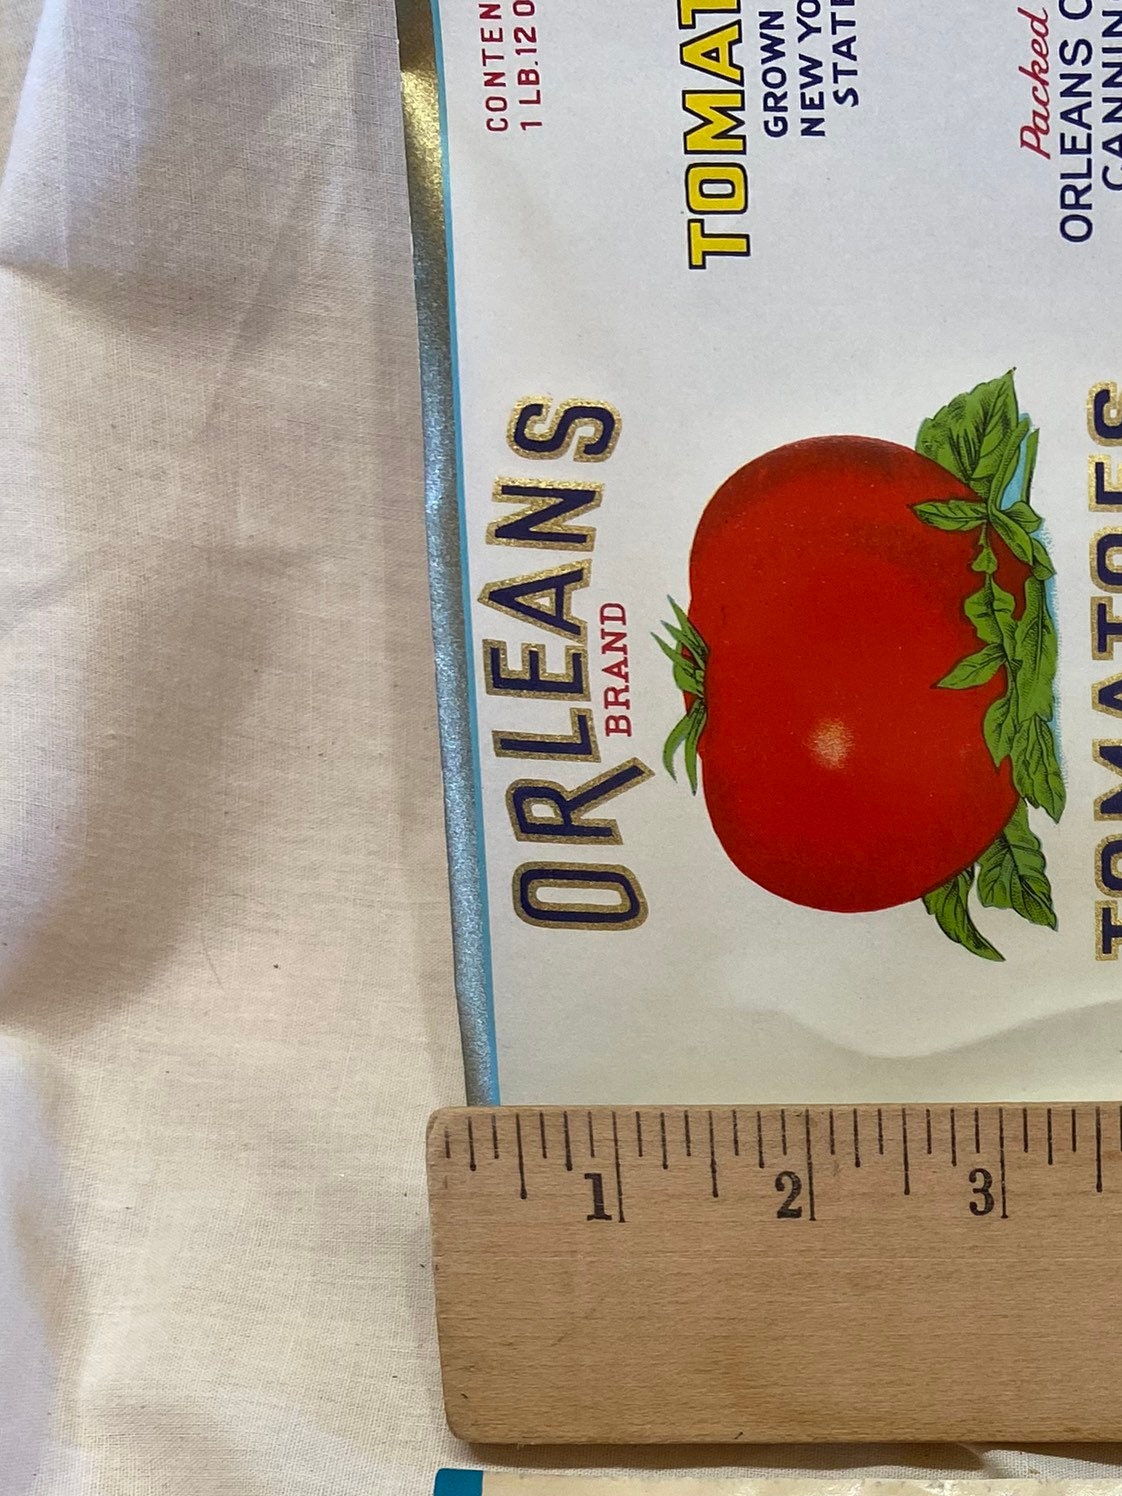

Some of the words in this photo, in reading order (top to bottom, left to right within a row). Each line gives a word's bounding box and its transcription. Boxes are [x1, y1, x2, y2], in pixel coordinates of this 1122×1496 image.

[478, 3, 508, 132] CONTEN
[758, 11, 789, 138] GROWN
[796, 0, 822, 43] YO
[1017, 6, 1052, 161] Packed
[520, 121, 543, 132] 1
[677, 0, 750, 270] TOMAT
[798, 53, 826, 137] NEW
[1058, 38, 1094, 243] ORLEANS
[477, 395, 655, 932] ORLEANS
[599, 601, 633, 738] BRAND
[584, 1172, 613, 1221] 1
[774, 1170, 803, 1220] 2
[967, 1166, 995, 1217] 3
